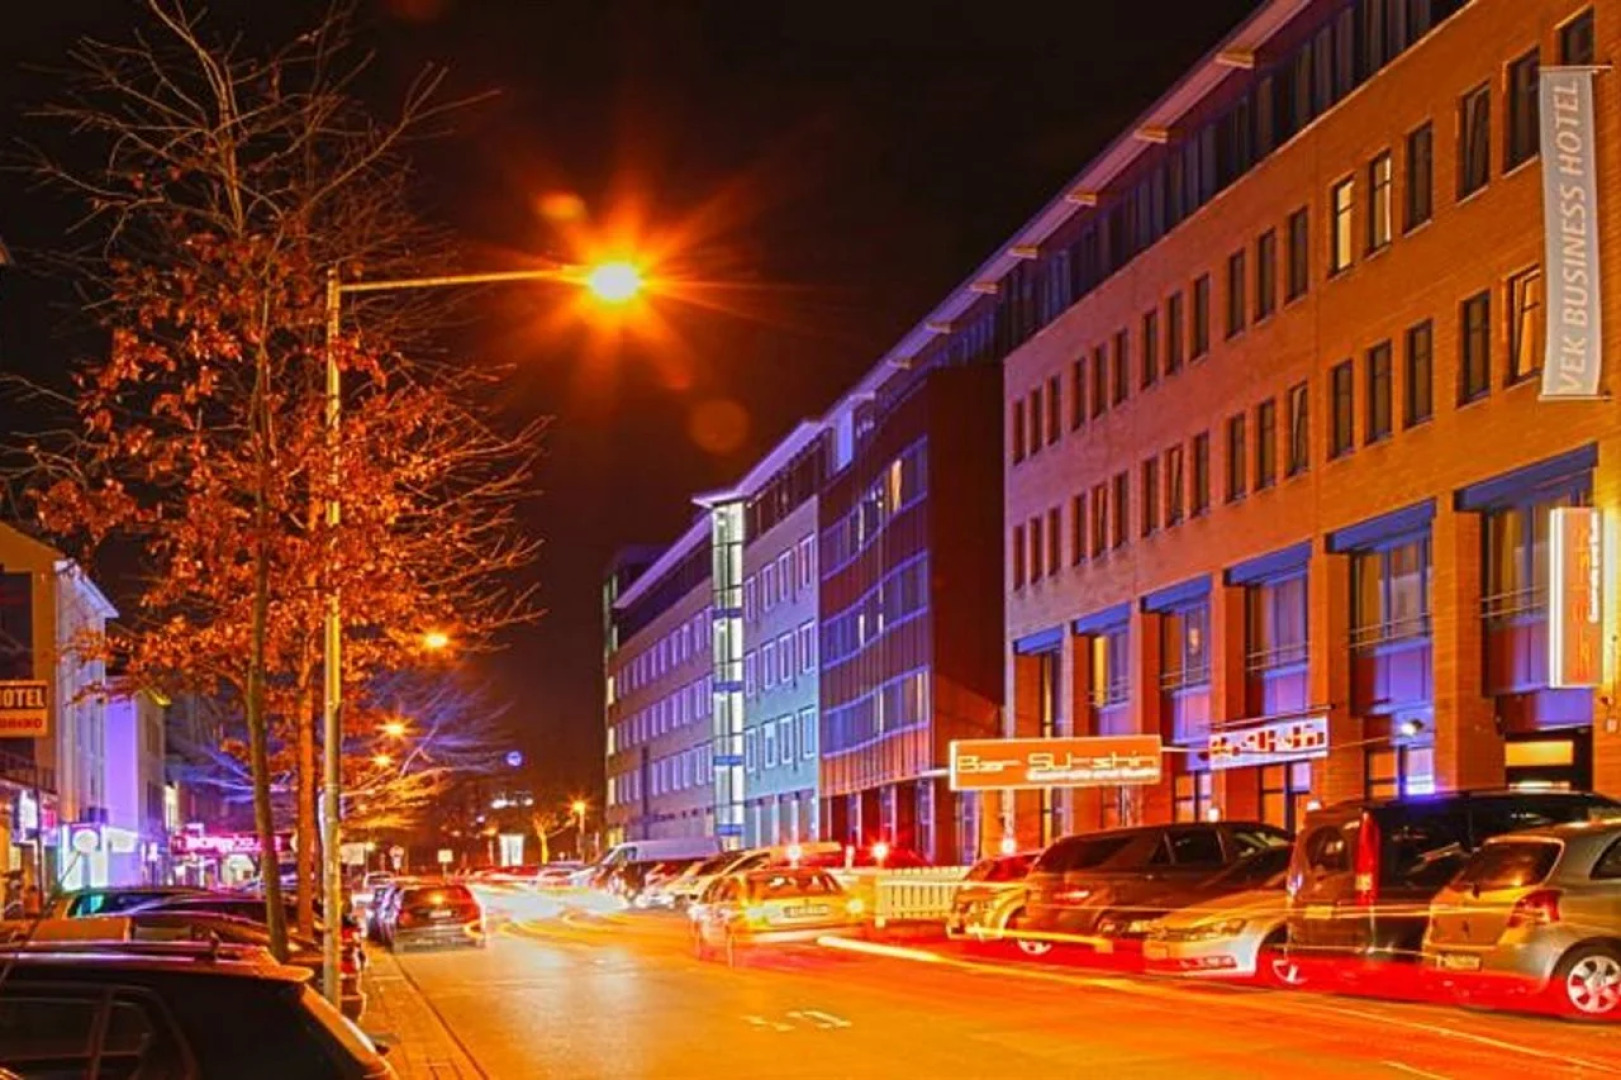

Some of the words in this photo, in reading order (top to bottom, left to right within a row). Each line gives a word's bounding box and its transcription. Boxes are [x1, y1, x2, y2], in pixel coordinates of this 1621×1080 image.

[1553, 80, 1584, 175] HOTEL
[1559, 184, 1589, 327] BUSINESS
[1559, 336, 1588, 395] VEK
